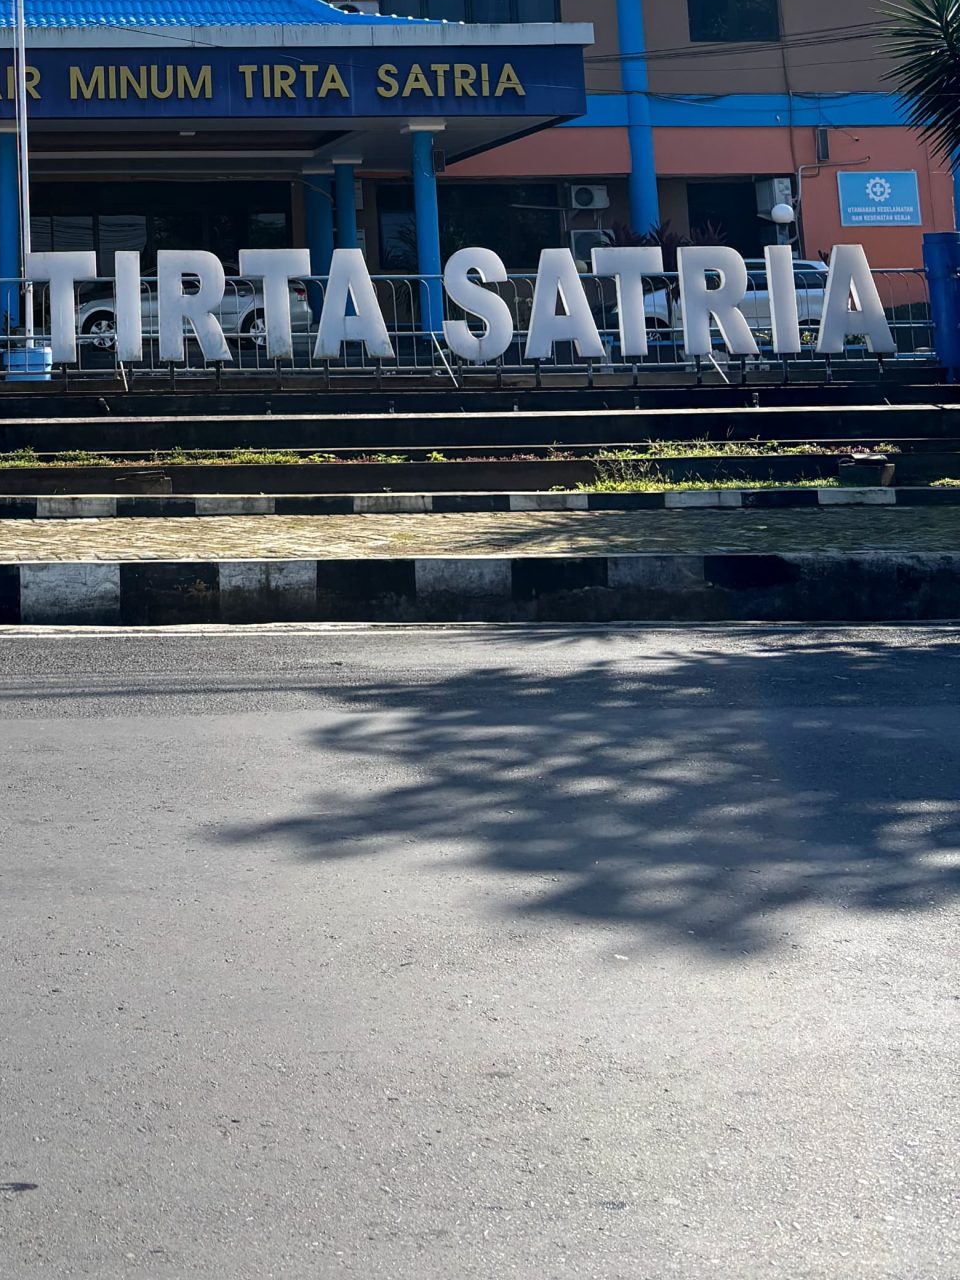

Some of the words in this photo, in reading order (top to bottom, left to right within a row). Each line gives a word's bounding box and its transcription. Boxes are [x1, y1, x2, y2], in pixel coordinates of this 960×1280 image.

[69, 65, 212, 100] MINUM
[239, 64, 349, 98] TIRTA
[377, 63, 526, 98] SATRIA
[25, 249, 395, 363] TIRTA
[442, 244, 897, 362] SATRIA
